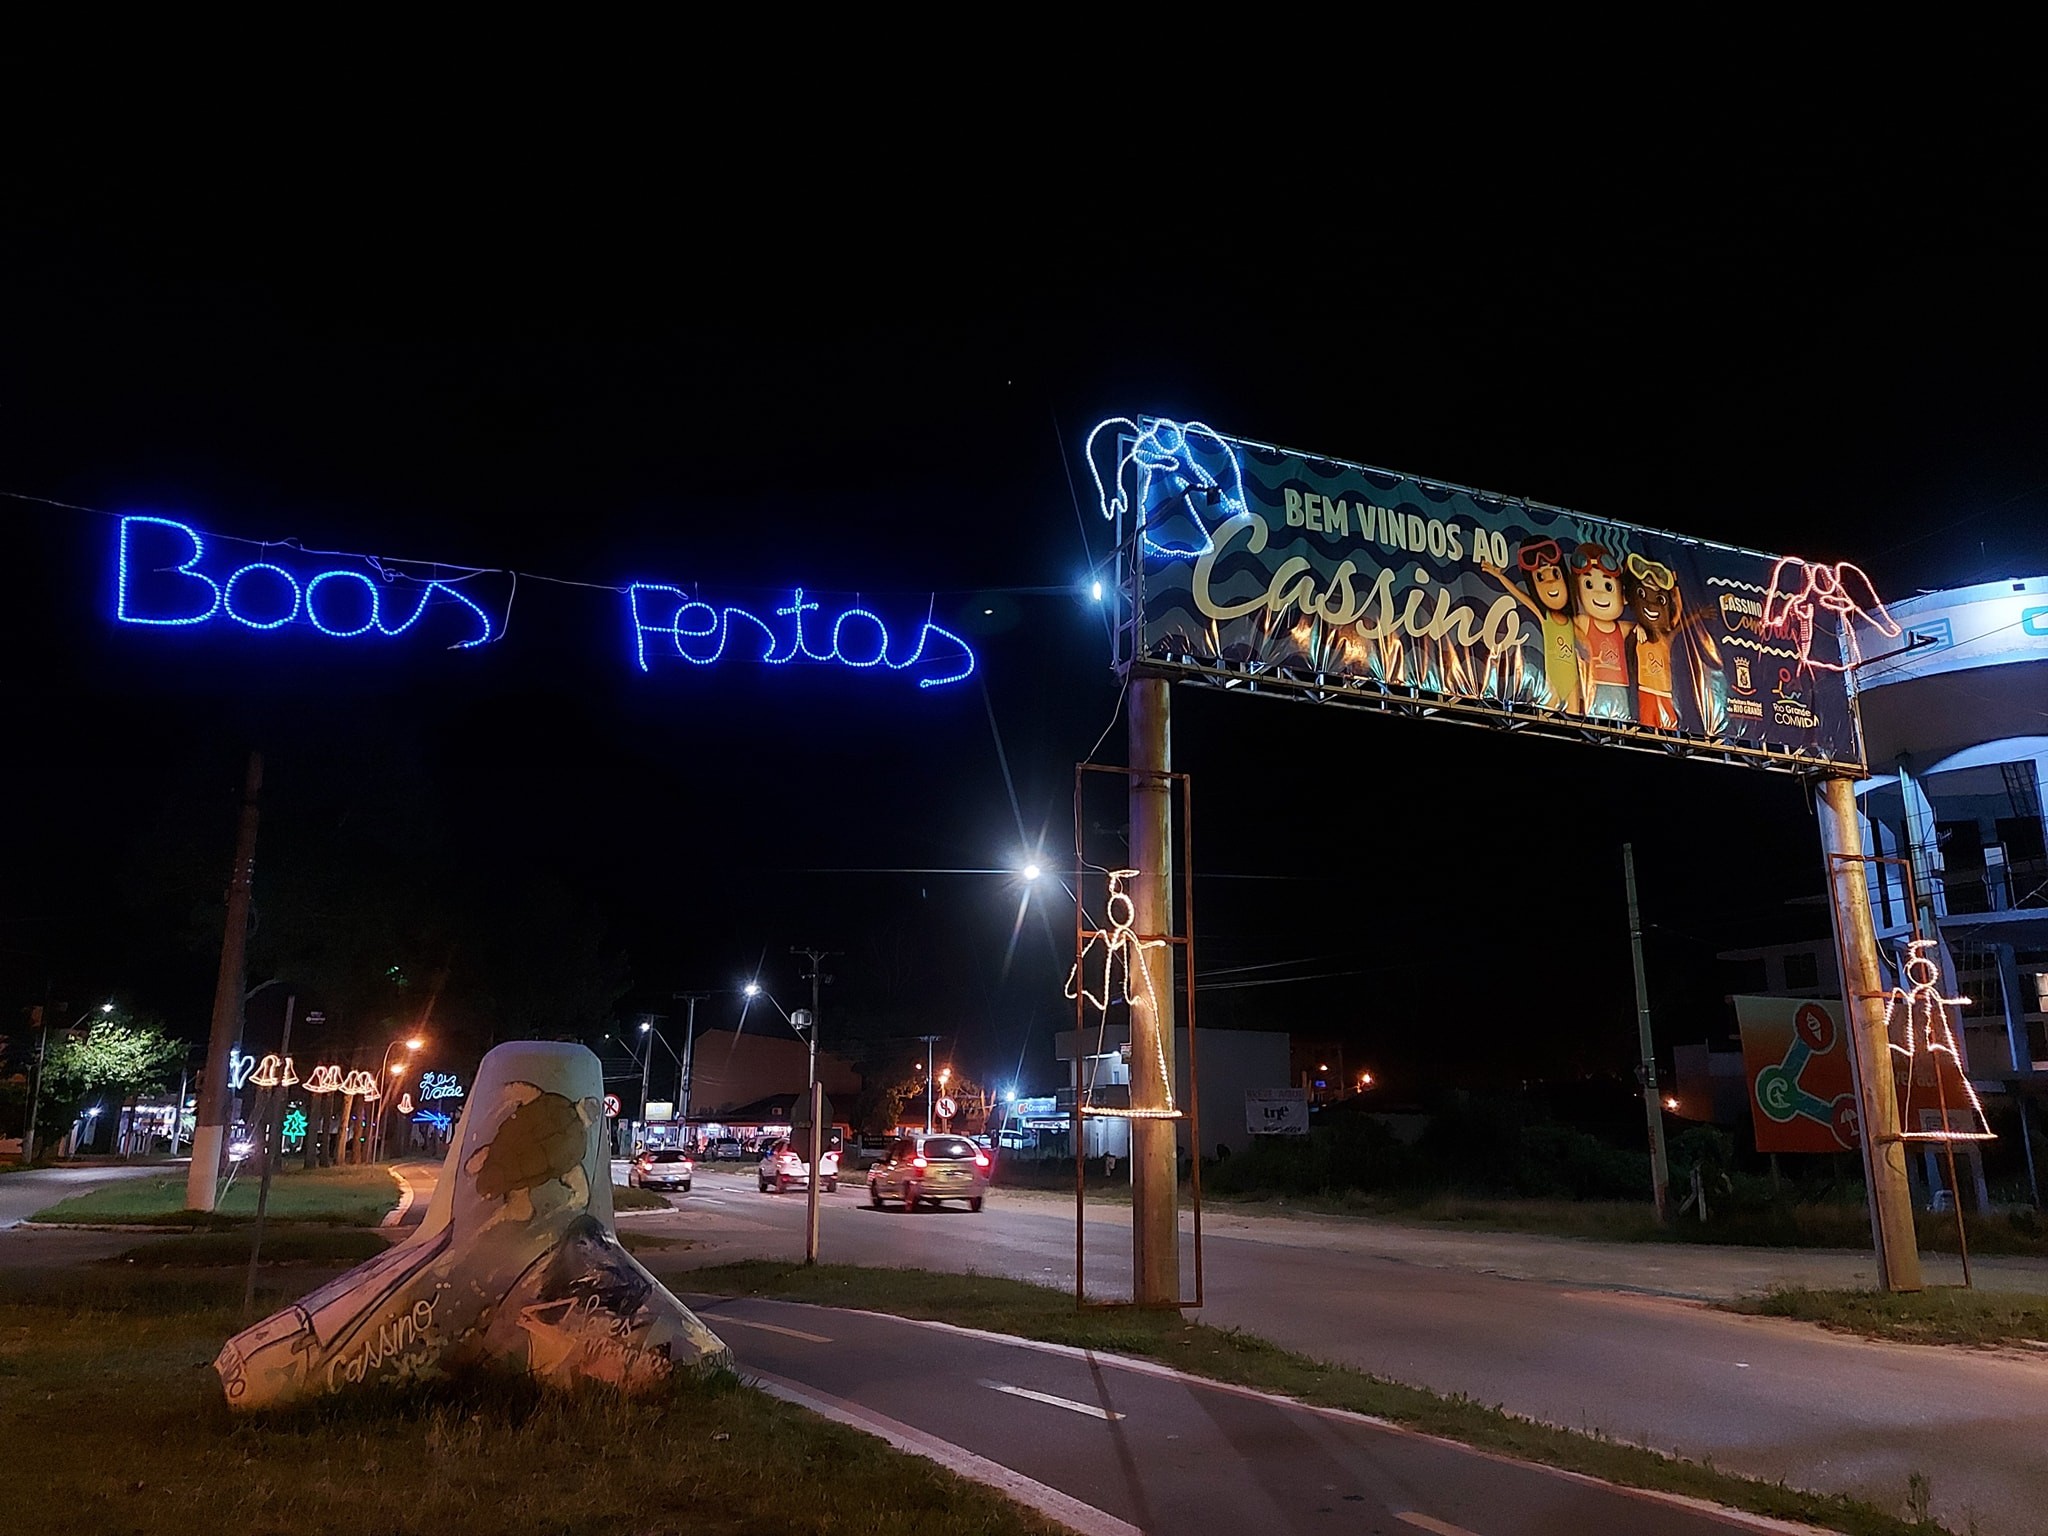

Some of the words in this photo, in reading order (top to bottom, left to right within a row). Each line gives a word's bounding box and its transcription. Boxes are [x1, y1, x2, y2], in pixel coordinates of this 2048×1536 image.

[1284, 487, 1349, 538] BEM
[1358, 502, 1463, 563] VINDOS
[1472, 526, 1510, 569] AO
[1192, 511, 1531, 652] Cassino
[118, 516, 490, 649] Boas
[629, 583, 975, 688] Festas
[1719, 595, 1763, 618] CASSINO
[1733, 704, 1743, 714] RIO
[1743, 705, 1764, 717] GRANDE
[1772, 702, 1785, 713] Rio
[1785, 705, 1812, 717] Grande
[1774, 712, 1820, 728] CONVIDA
[420, 1085, 465, 1102] Natal
[327, 1293, 440, 1394] Cassino
